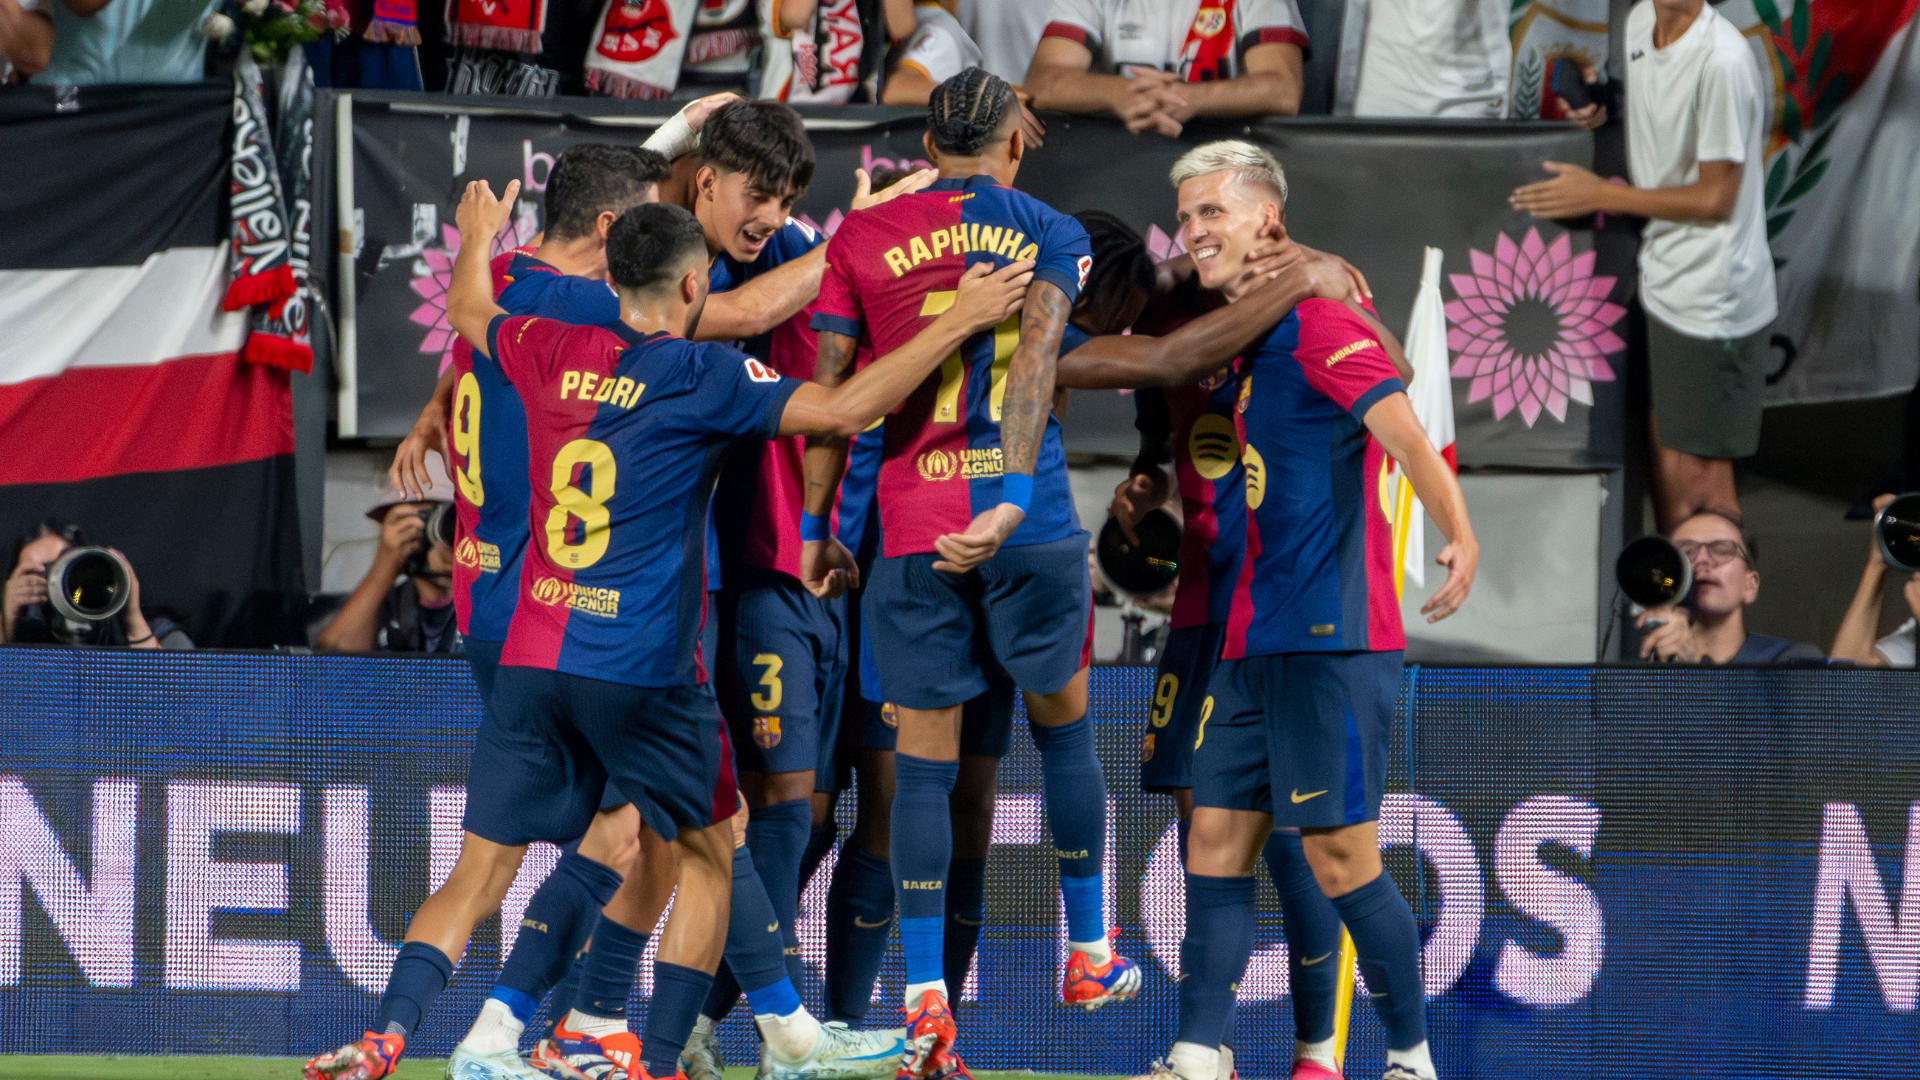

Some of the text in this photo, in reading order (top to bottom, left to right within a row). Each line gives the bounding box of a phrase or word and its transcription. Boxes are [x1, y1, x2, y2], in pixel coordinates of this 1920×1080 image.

[883, 223, 1039, 277] RAPHINHA
[1326, 339, 1371, 367] AMBILIGHT
[560, 370, 647, 410] PEDRI
[453, 372, 484, 507] 9
[960, 447, 1003, 462] UNHC
[960, 460, 1003, 474] ACNU
[545, 439, 616, 570] 8
[564, 595, 618, 613] ACNUR
[569, 582, 620, 602] UNHCR
[751, 653, 783, 711] 3
[1152, 673, 1179, 728] 9
